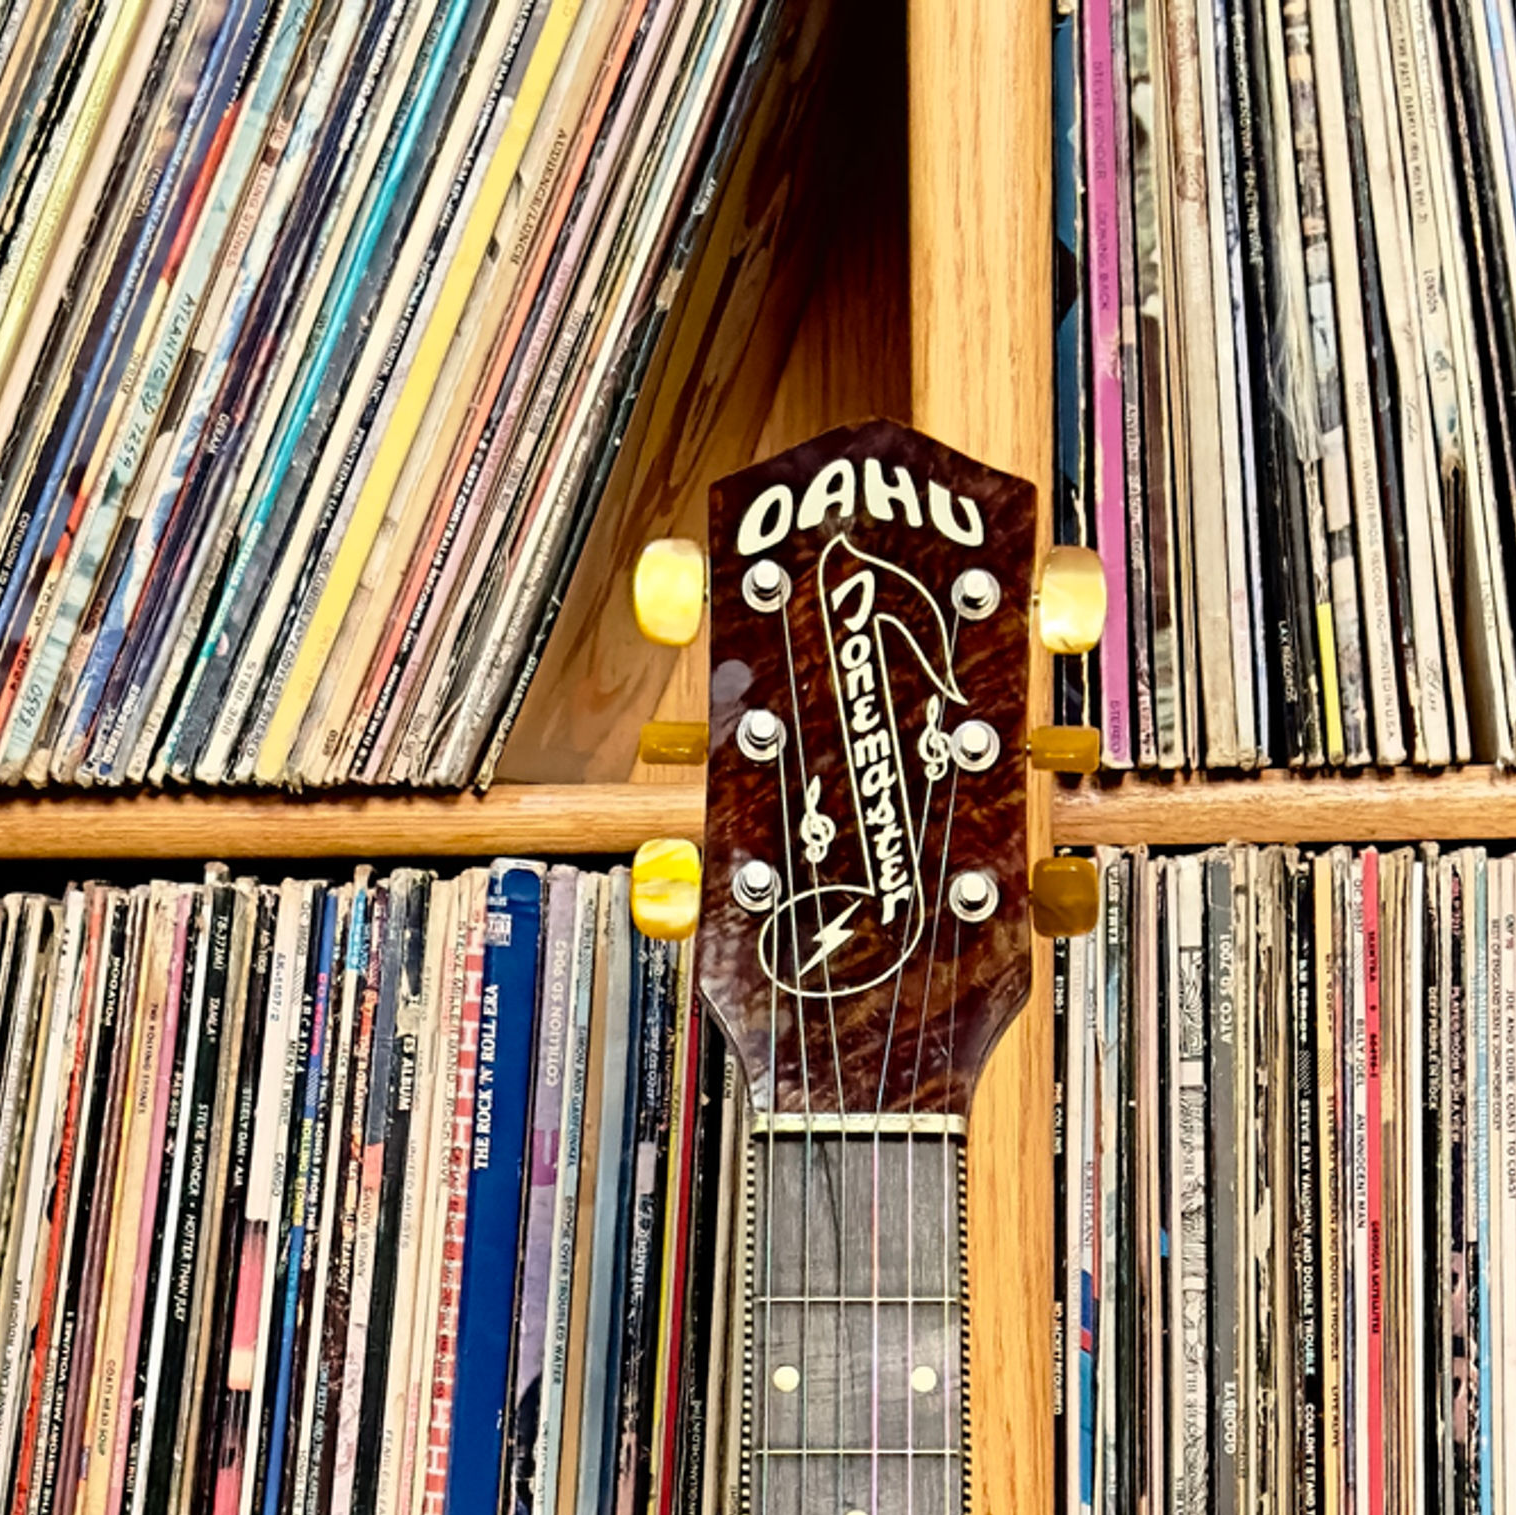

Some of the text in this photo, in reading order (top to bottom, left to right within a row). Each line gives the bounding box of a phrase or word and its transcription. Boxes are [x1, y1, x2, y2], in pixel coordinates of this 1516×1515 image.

[736, 457, 985, 557] OAHU
[472, 984, 499, 1170] THE ROCK 'N' ROLL ERA
[544, 939, 567, 1087] COTILLION SD 9042
